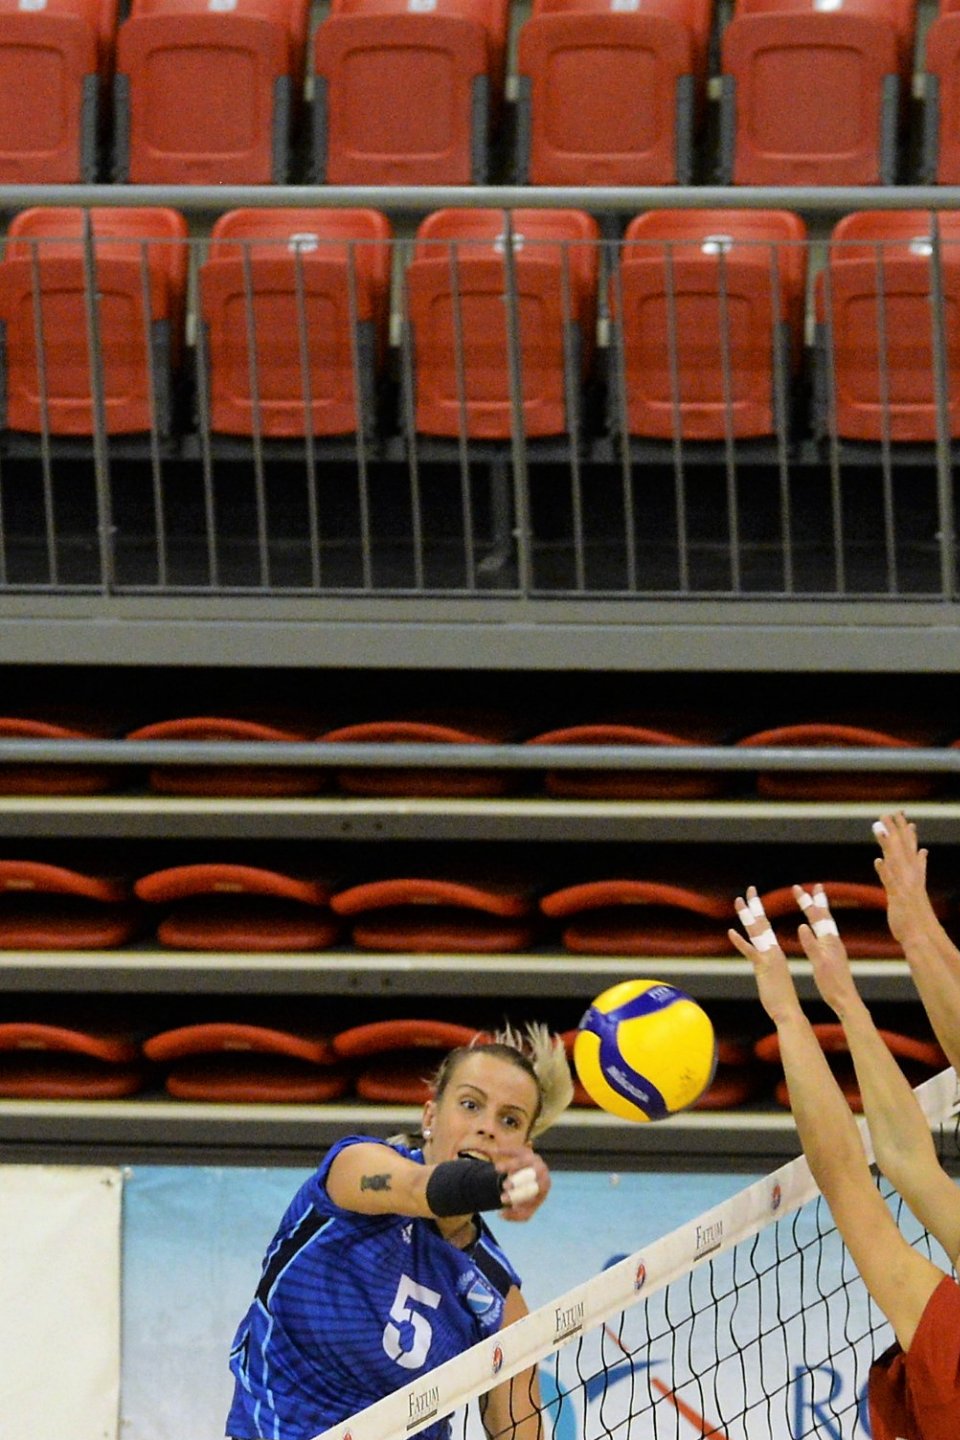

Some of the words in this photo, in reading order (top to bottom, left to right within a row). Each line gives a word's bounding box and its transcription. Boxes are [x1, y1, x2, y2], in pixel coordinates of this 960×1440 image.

[695, 1219, 724, 1250] FATUM
[382, 1272, 443, 1370] 5
[555, 1301, 584, 1332] FATUM
[408, 1385, 440, 1418] FATUM
